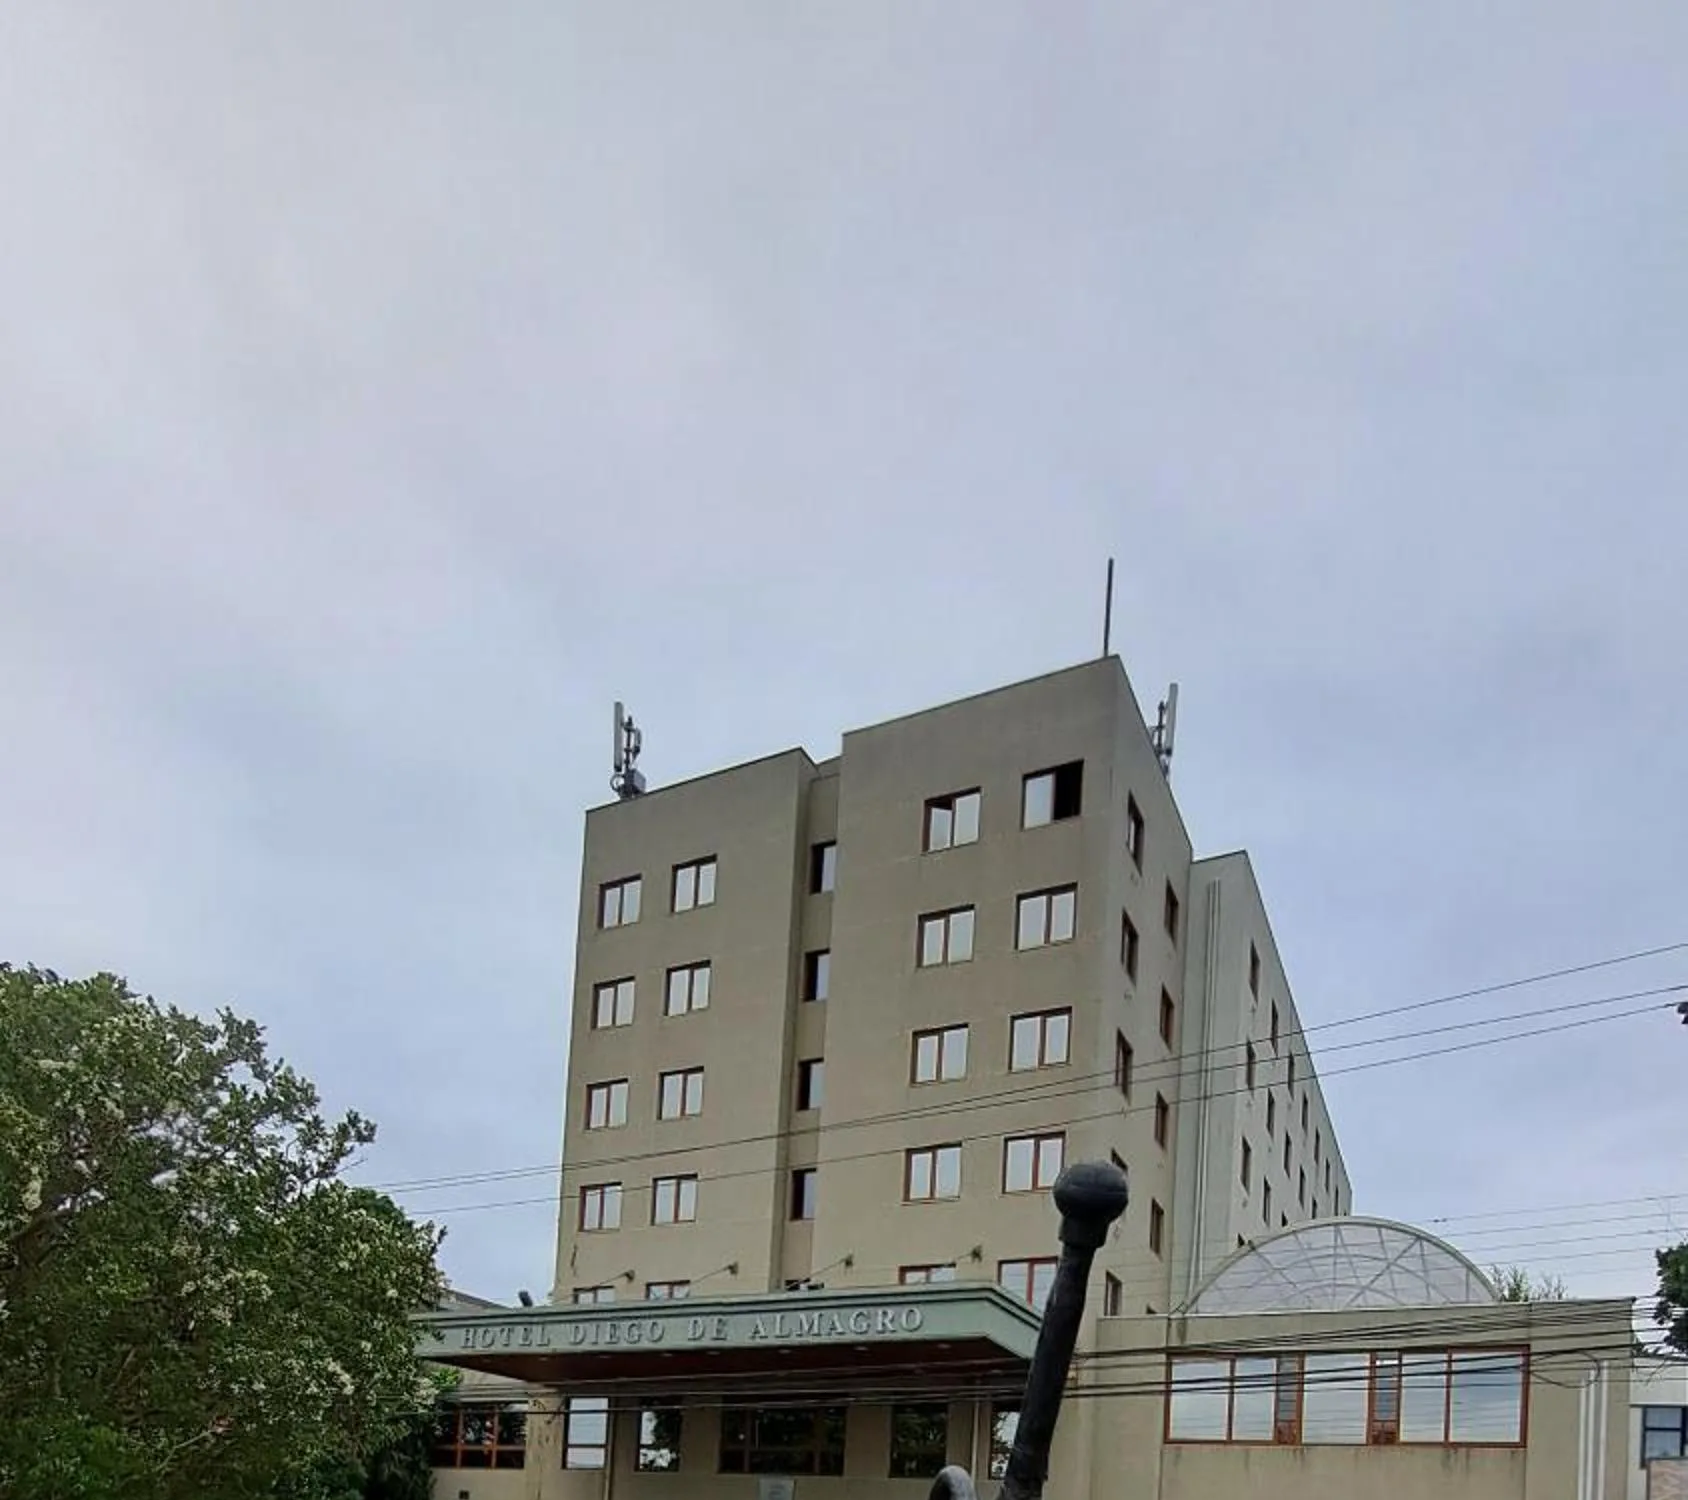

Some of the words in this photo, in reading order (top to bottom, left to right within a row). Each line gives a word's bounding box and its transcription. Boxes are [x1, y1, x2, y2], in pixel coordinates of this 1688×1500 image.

[461, 1327, 551, 1349] HOTEL
[569, 1322, 665, 1346] DIEGO
[687, 1316, 729, 1341] DE
[750, 1307, 923, 1340] ALMAGRO
